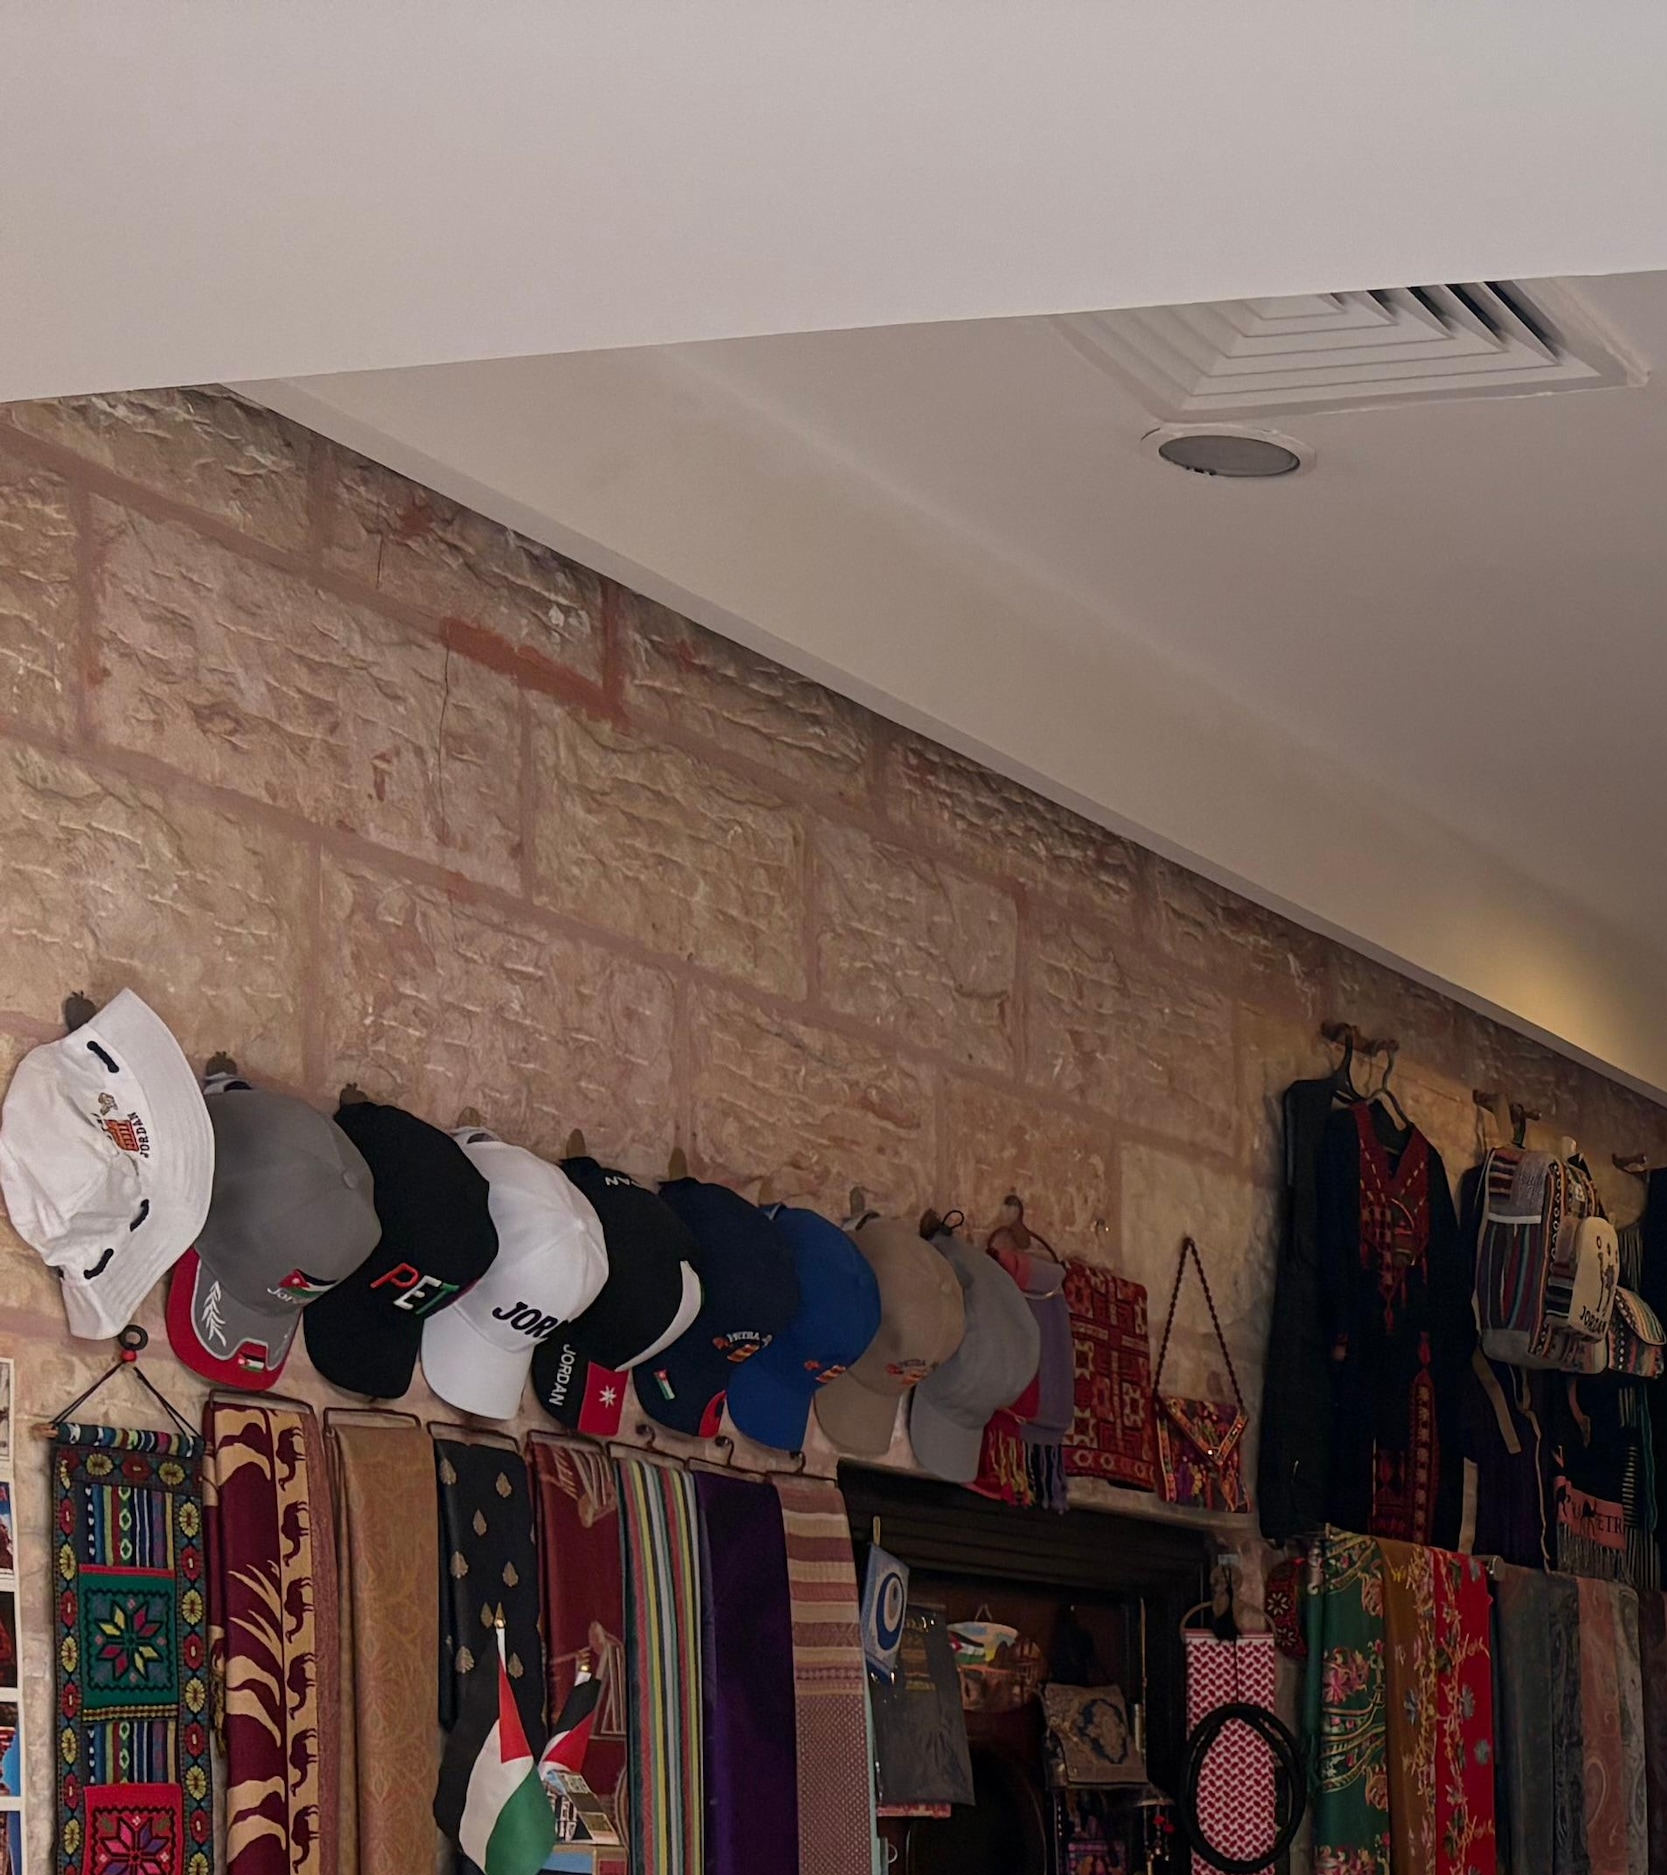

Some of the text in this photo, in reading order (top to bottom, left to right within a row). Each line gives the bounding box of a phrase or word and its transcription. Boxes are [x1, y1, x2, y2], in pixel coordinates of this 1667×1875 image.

[127, 1112, 150, 1158] JORDAN
[370, 1262, 460, 1315] PET
[548, 1344, 577, 1406] JORDAN
